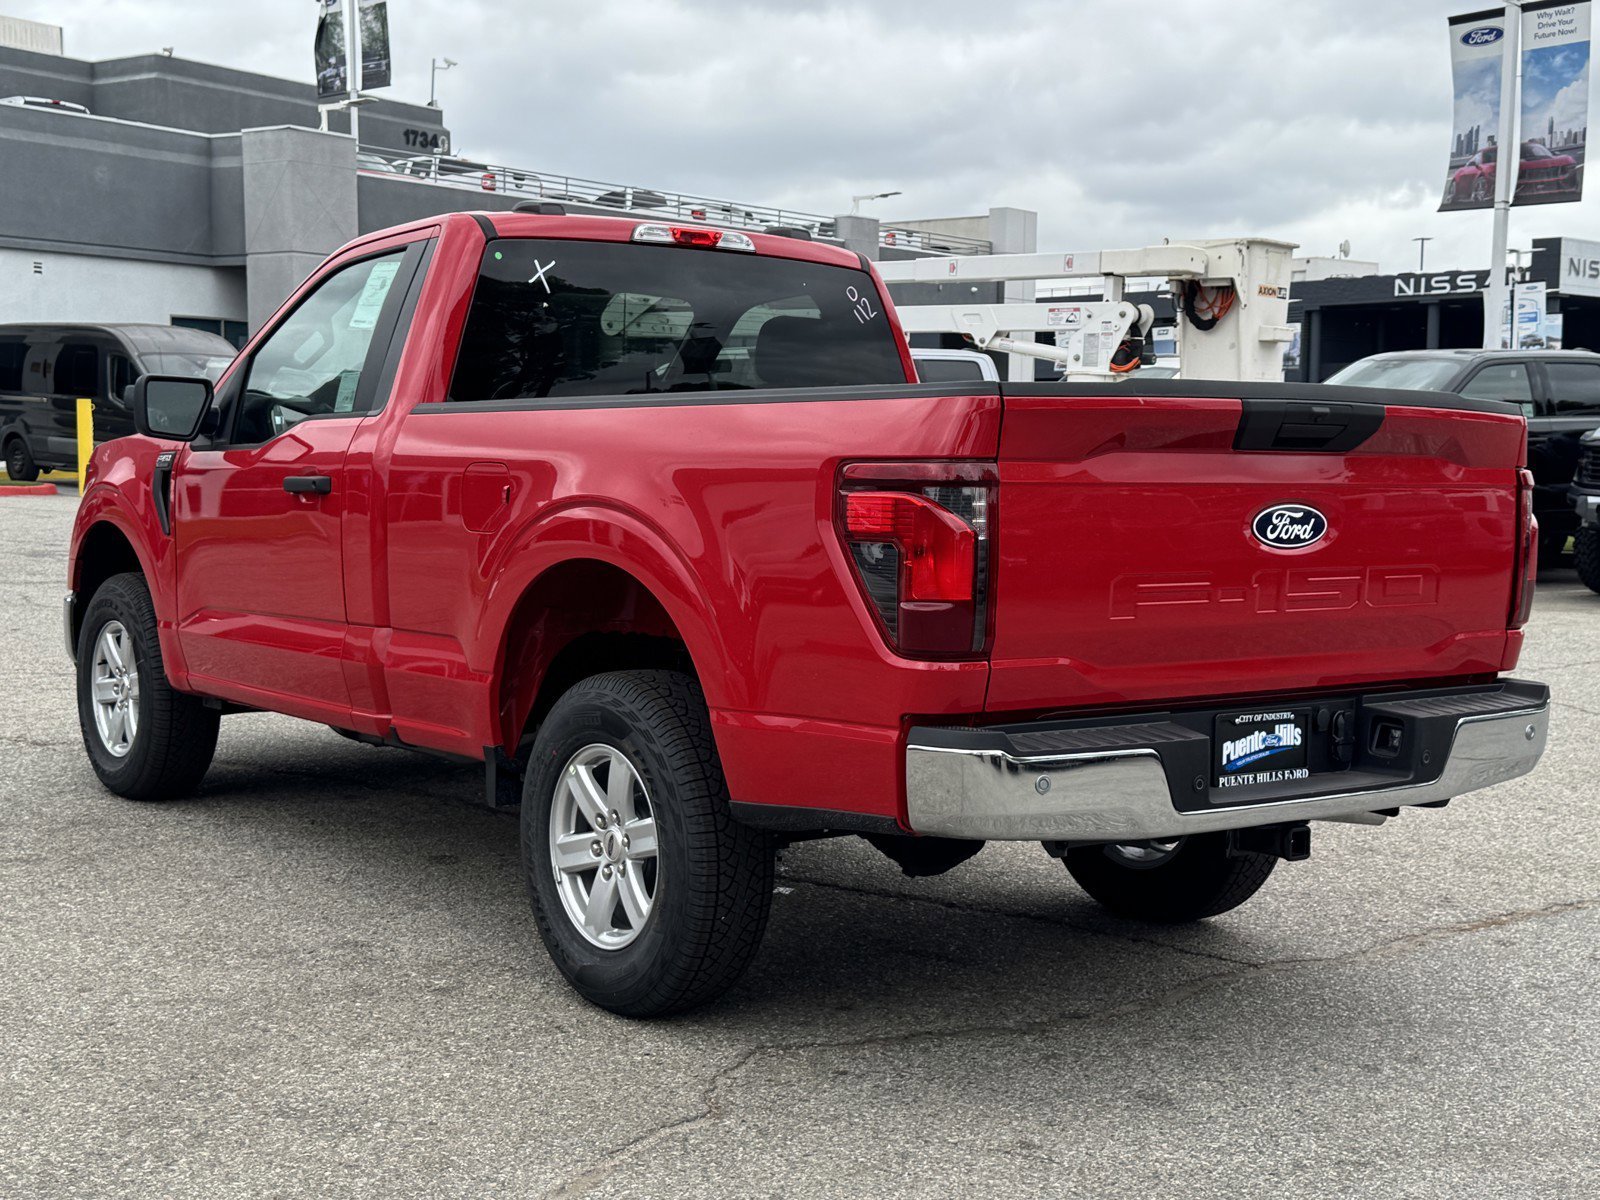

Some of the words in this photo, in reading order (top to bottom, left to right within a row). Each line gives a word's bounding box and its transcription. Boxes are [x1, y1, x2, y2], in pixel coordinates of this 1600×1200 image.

[1536, 11, 1554, 20] Why
[1554, 6, 1576, 16] Wait?
[1537, 21, 1557, 30] Drive
[1557, 18, 1575, 26] Your
[1468, 28, 1498, 44] Ford
[1533, 31, 1557, 40] Future
[1557, 26, 1578, 36] Now!
[1265, 510, 1316, 540] Ford
[1109, 563, 1441, 620] F-150
[1239, 714, 1254, 723] CITY
[1254, 713, 1263, 722] OF
[1263, 712, 1291, 721] INDUSTRY
[1222, 731, 1267, 766] Puente
[1275, 724, 1302, 746] Hills
[1219, 775, 1255, 787] PUENTE
[1257, 772, 1283, 783] HILLS
[1285, 769, 1309, 780] FORD
